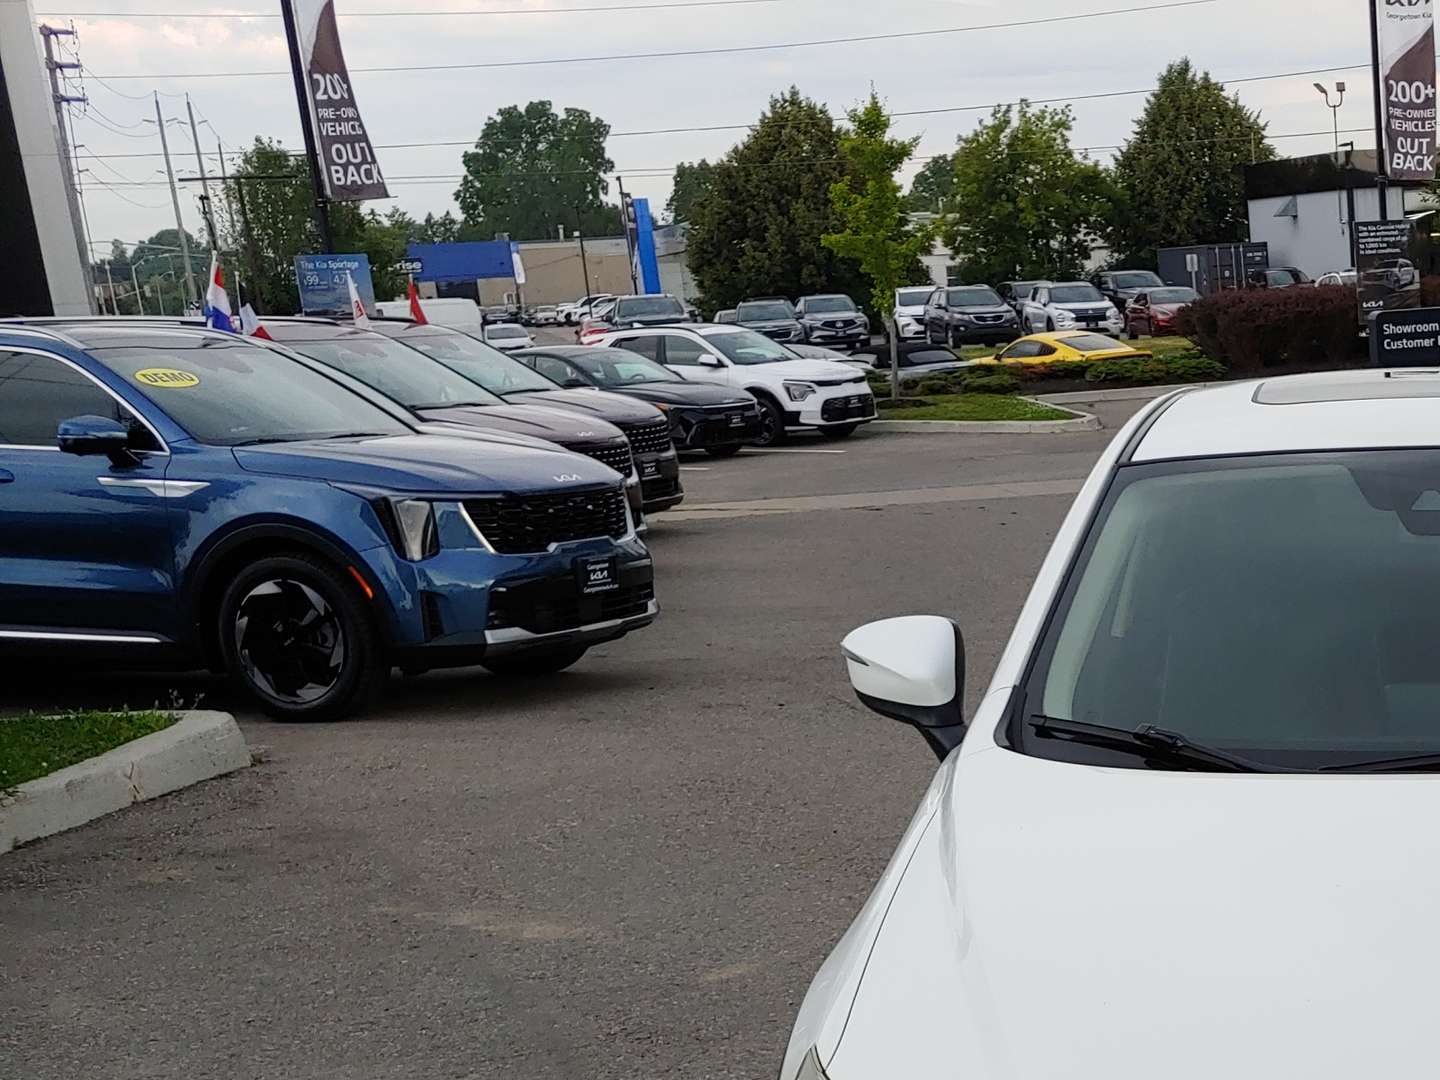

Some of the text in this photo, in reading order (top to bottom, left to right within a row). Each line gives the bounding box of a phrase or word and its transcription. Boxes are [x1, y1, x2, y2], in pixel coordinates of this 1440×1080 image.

[1388, 80, 1436, 103] 200+
[1396, 136, 1431, 155] OUT
[1391, 153, 1435, 172] BACK
[330, 163, 383, 186] BACK
[1383, 322, 1440, 335] Showroom
[1383, 337, 1436, 350] Customer
